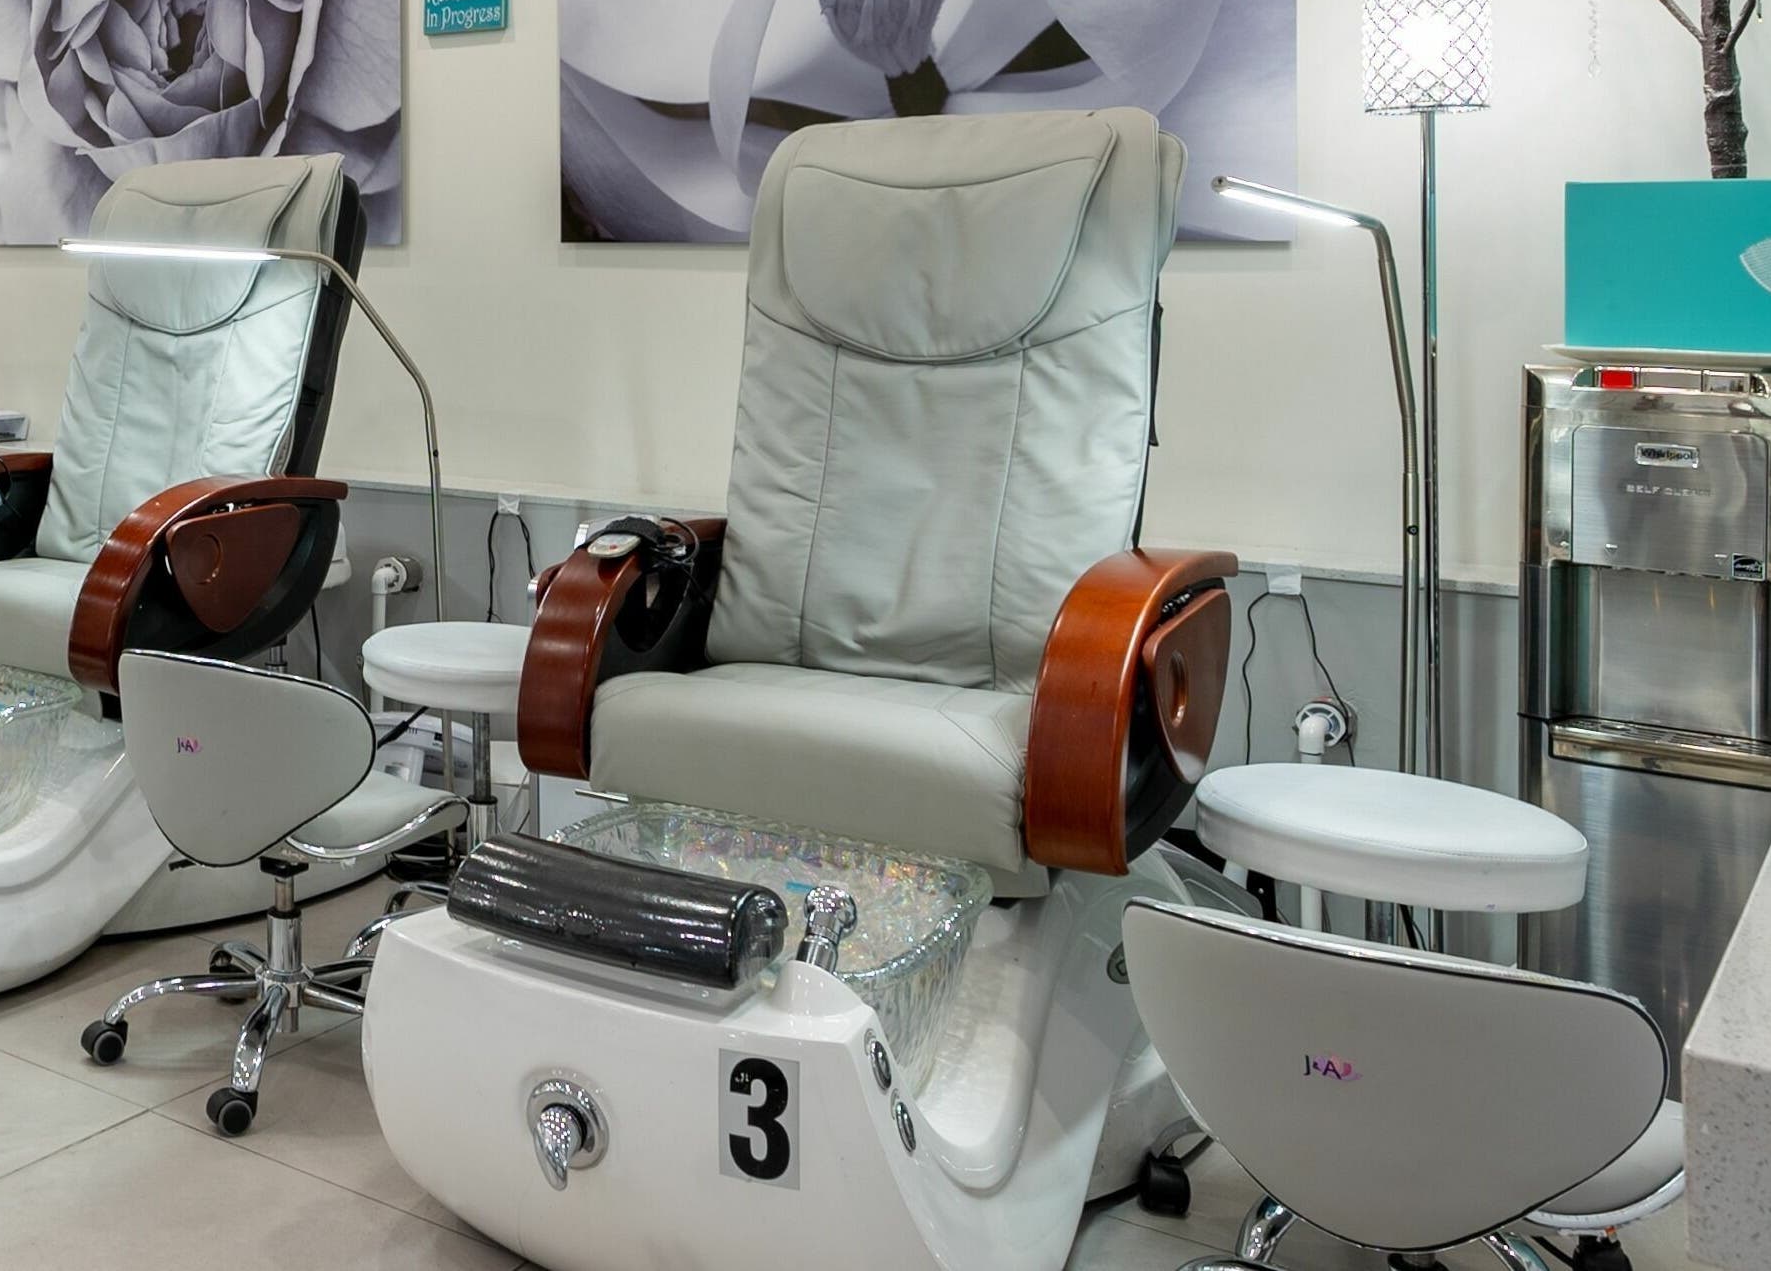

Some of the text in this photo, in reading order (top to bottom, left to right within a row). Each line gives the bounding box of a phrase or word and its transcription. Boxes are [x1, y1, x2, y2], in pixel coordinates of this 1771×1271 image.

[426, 6, 501, 30] In Progress
[1640, 447, 1694, 461] Whirlpool
[729, 1058, 790, 1180] 3
